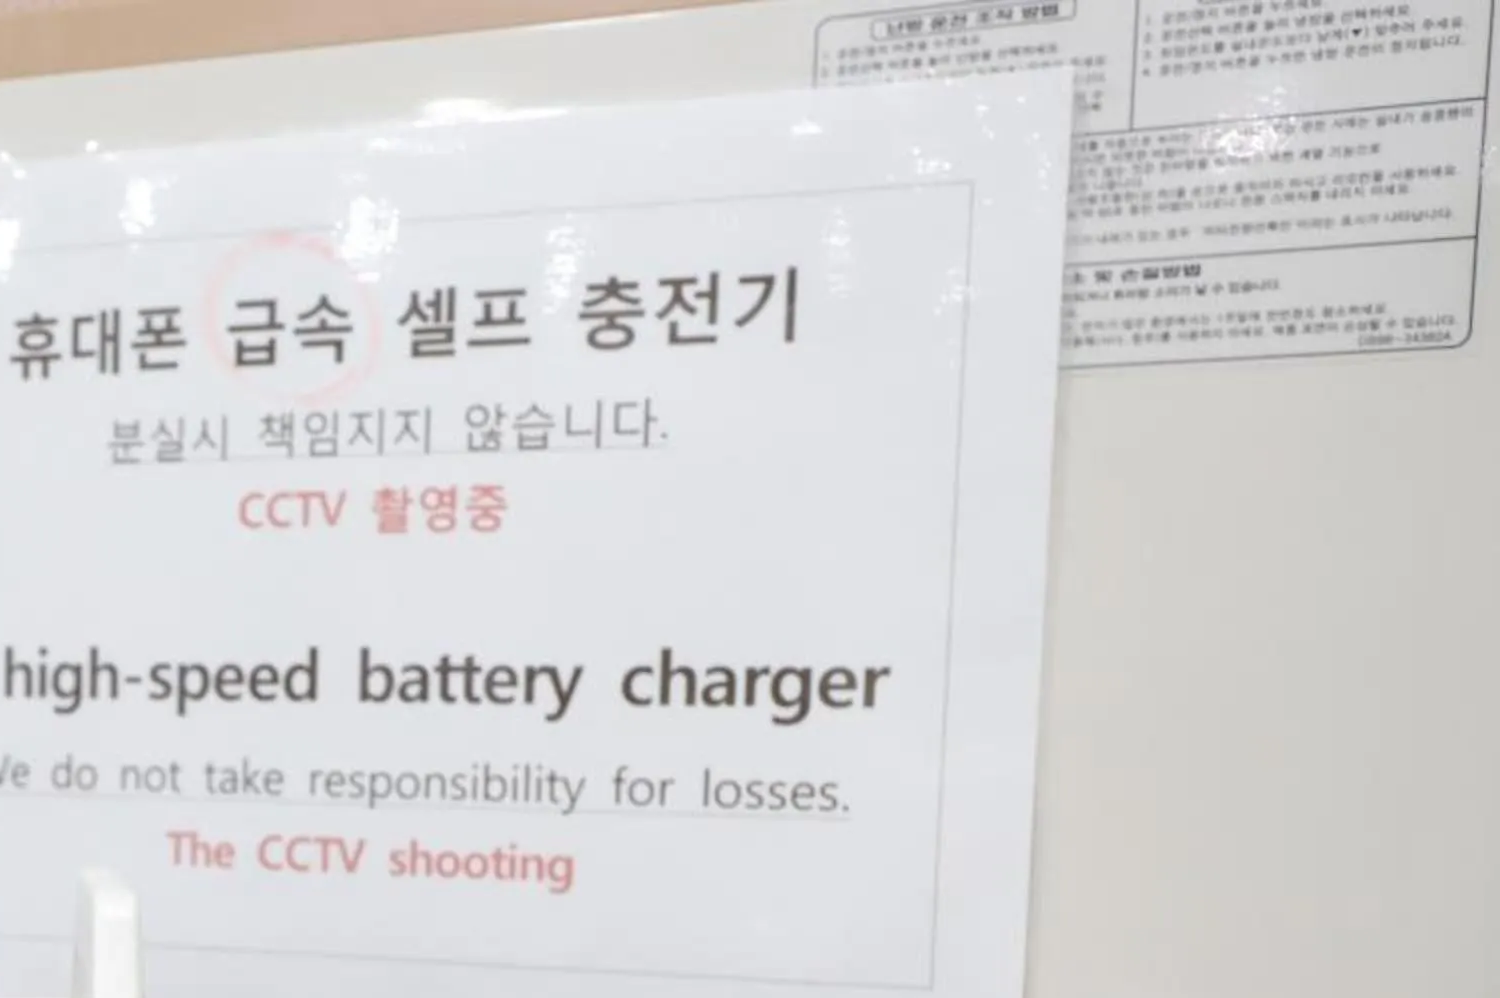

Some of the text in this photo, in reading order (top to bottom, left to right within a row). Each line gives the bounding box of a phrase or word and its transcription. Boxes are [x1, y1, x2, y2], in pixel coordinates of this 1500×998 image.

[10, 266, 797, 380] 휴대폰 급속 셀프 충전기
[108, 397, 668, 465] 분실시 책임지지 않습니다.
[239, 485, 508, 534] CCTV 촬영중
[5, 646, 318, 716] high-speed
[359, 647, 583, 722] battery
[622, 649, 890, 726] charger
[51, 754, 98, 791] do
[120, 762, 181, 794] not
[205, 758, 284, 796] take
[309, 763, 586, 816] responsibility
[613, 765, 674, 807] for
[703, 768, 849, 812] losses.
[166, 831, 574, 894] The CCTV shooting
